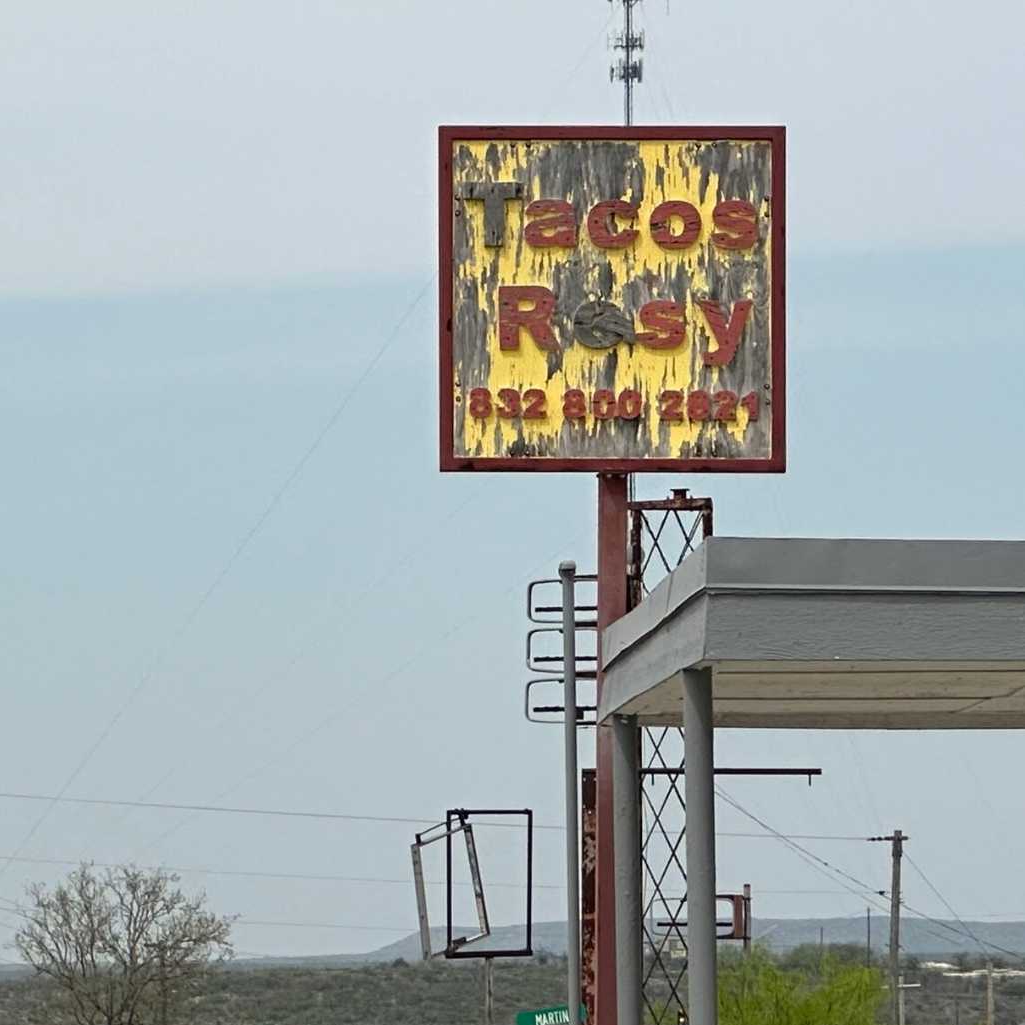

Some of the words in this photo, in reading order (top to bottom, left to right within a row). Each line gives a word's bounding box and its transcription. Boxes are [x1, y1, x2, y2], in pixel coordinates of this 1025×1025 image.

[463, 181, 758, 250] Tacos
[498, 285, 753, 367] Rosy
[469, 387, 547, 419] 832
[562, 389, 643, 420] 800
